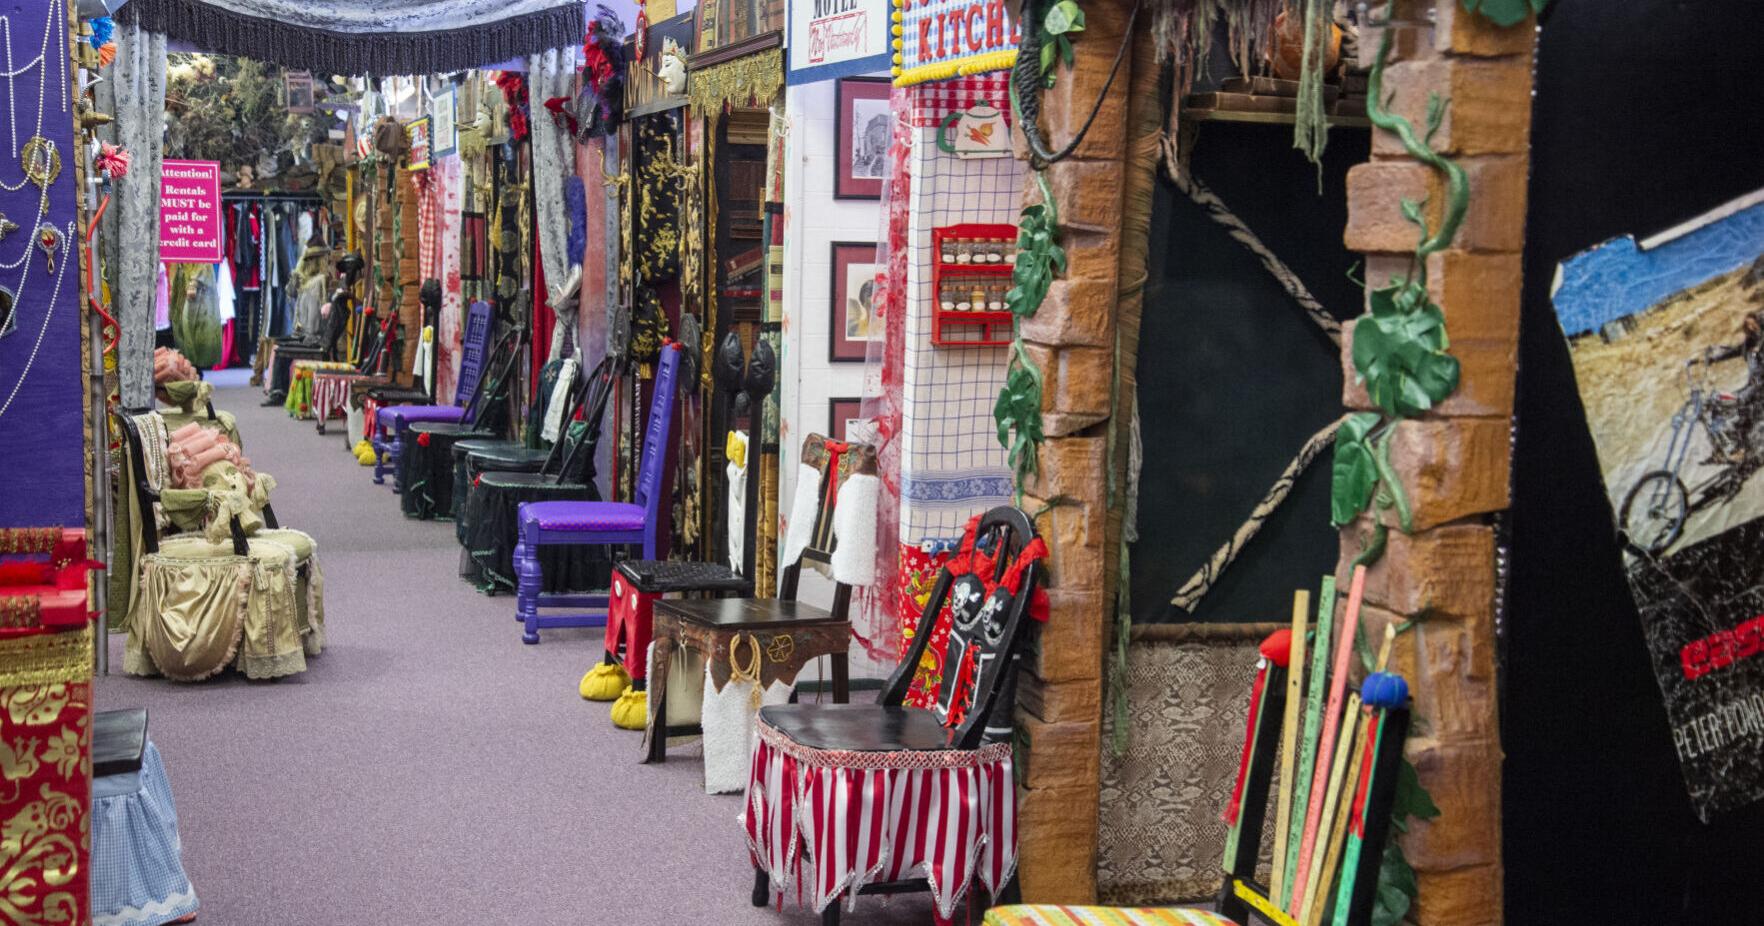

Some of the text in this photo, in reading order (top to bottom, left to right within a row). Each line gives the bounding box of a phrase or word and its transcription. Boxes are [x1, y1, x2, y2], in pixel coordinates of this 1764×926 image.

[165, 185, 206, 195] Rentals
[161, 198, 211, 209] MUST be
[164, 212, 209, 222] paid for
[170, 225, 195, 235] with
[192, 239, 217, 248] card
[1673, 712, 1724, 763] PETER
